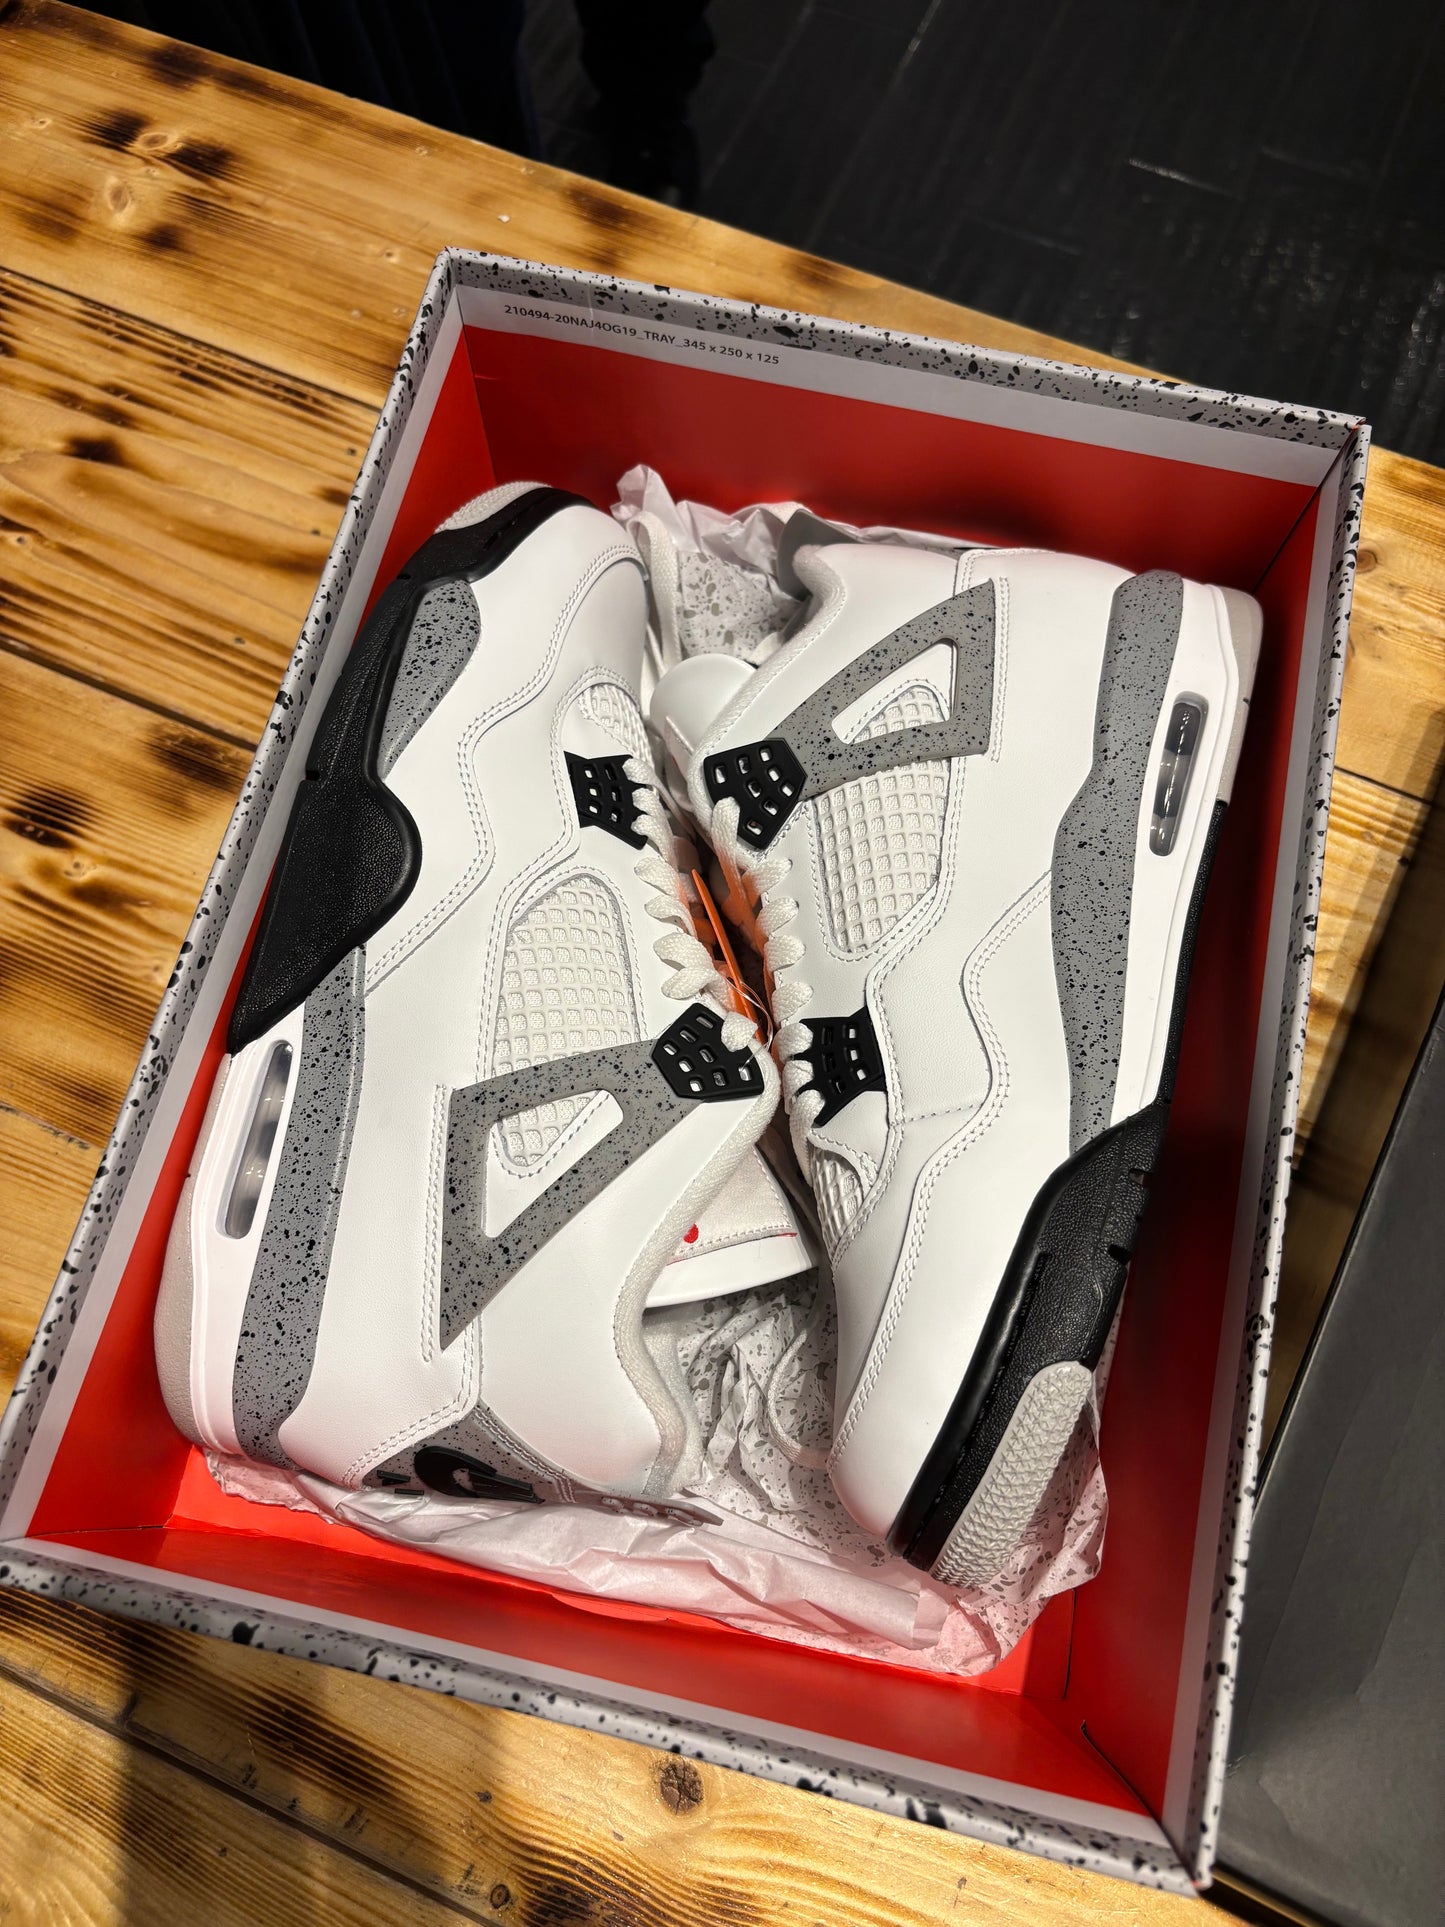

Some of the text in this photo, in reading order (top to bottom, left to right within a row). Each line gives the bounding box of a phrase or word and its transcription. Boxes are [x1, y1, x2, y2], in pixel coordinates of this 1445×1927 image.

[708, 344, 717, 353] x
[719, 345, 743, 358] 250
[745, 352, 753, 360] x
[757, 353, 780, 365] 125
